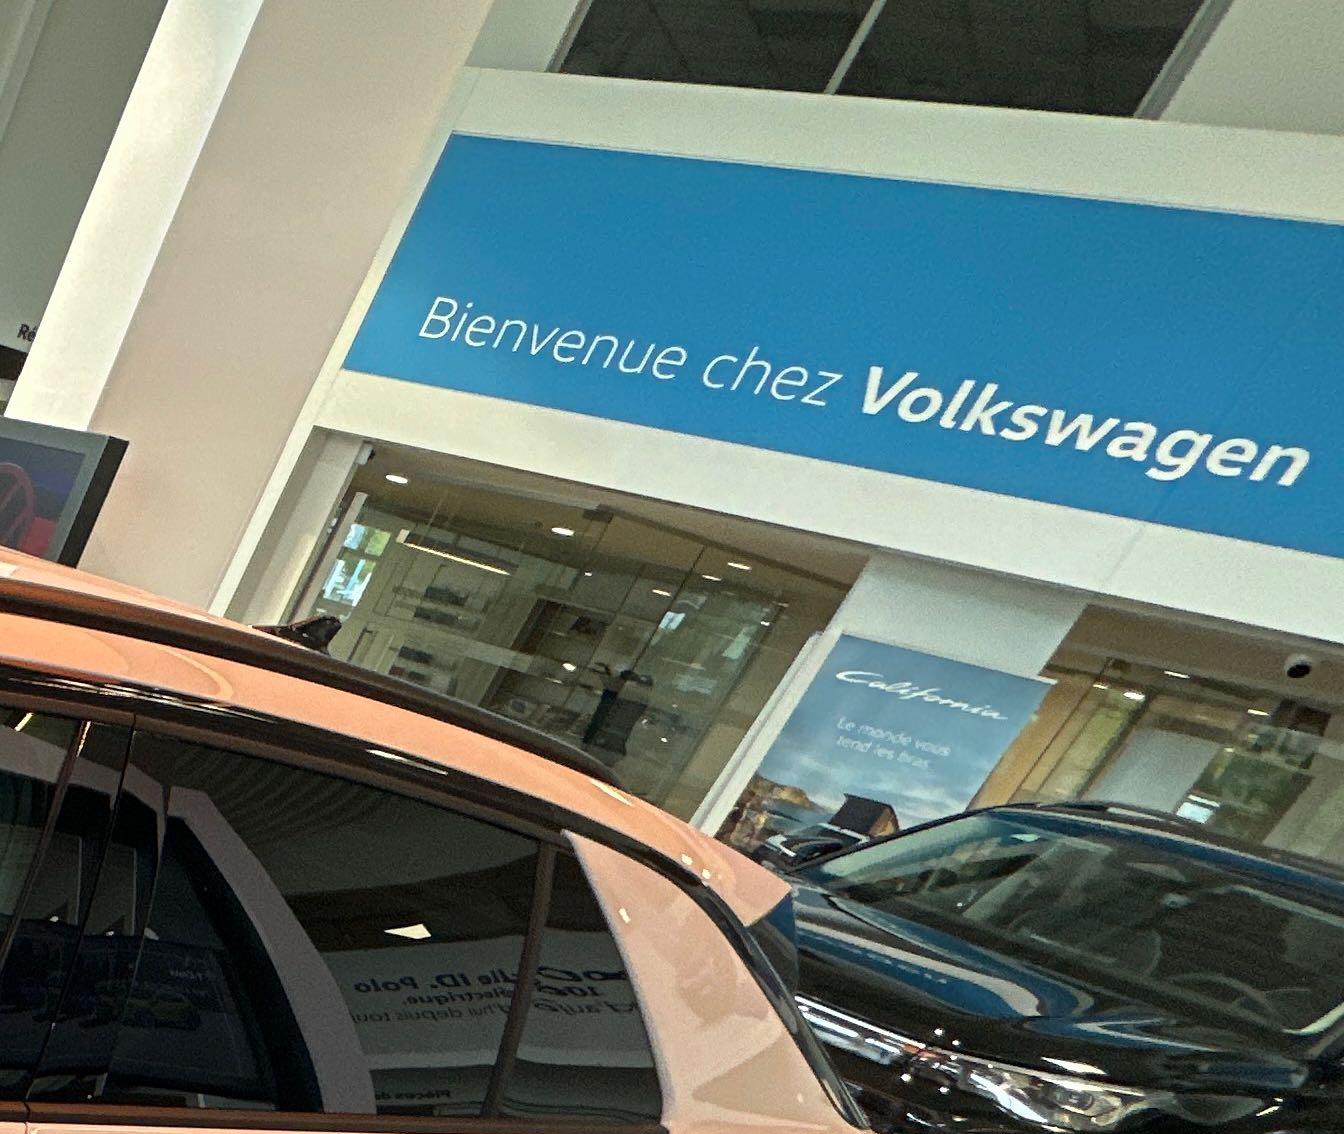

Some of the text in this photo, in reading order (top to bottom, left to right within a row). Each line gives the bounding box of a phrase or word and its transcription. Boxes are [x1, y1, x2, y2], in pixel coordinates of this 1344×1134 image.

[418, 296, 1311, 487] Bienvenue chez Volkswagen
[835, 670, 1009, 720] California
[836, 716, 856, 732] Le
